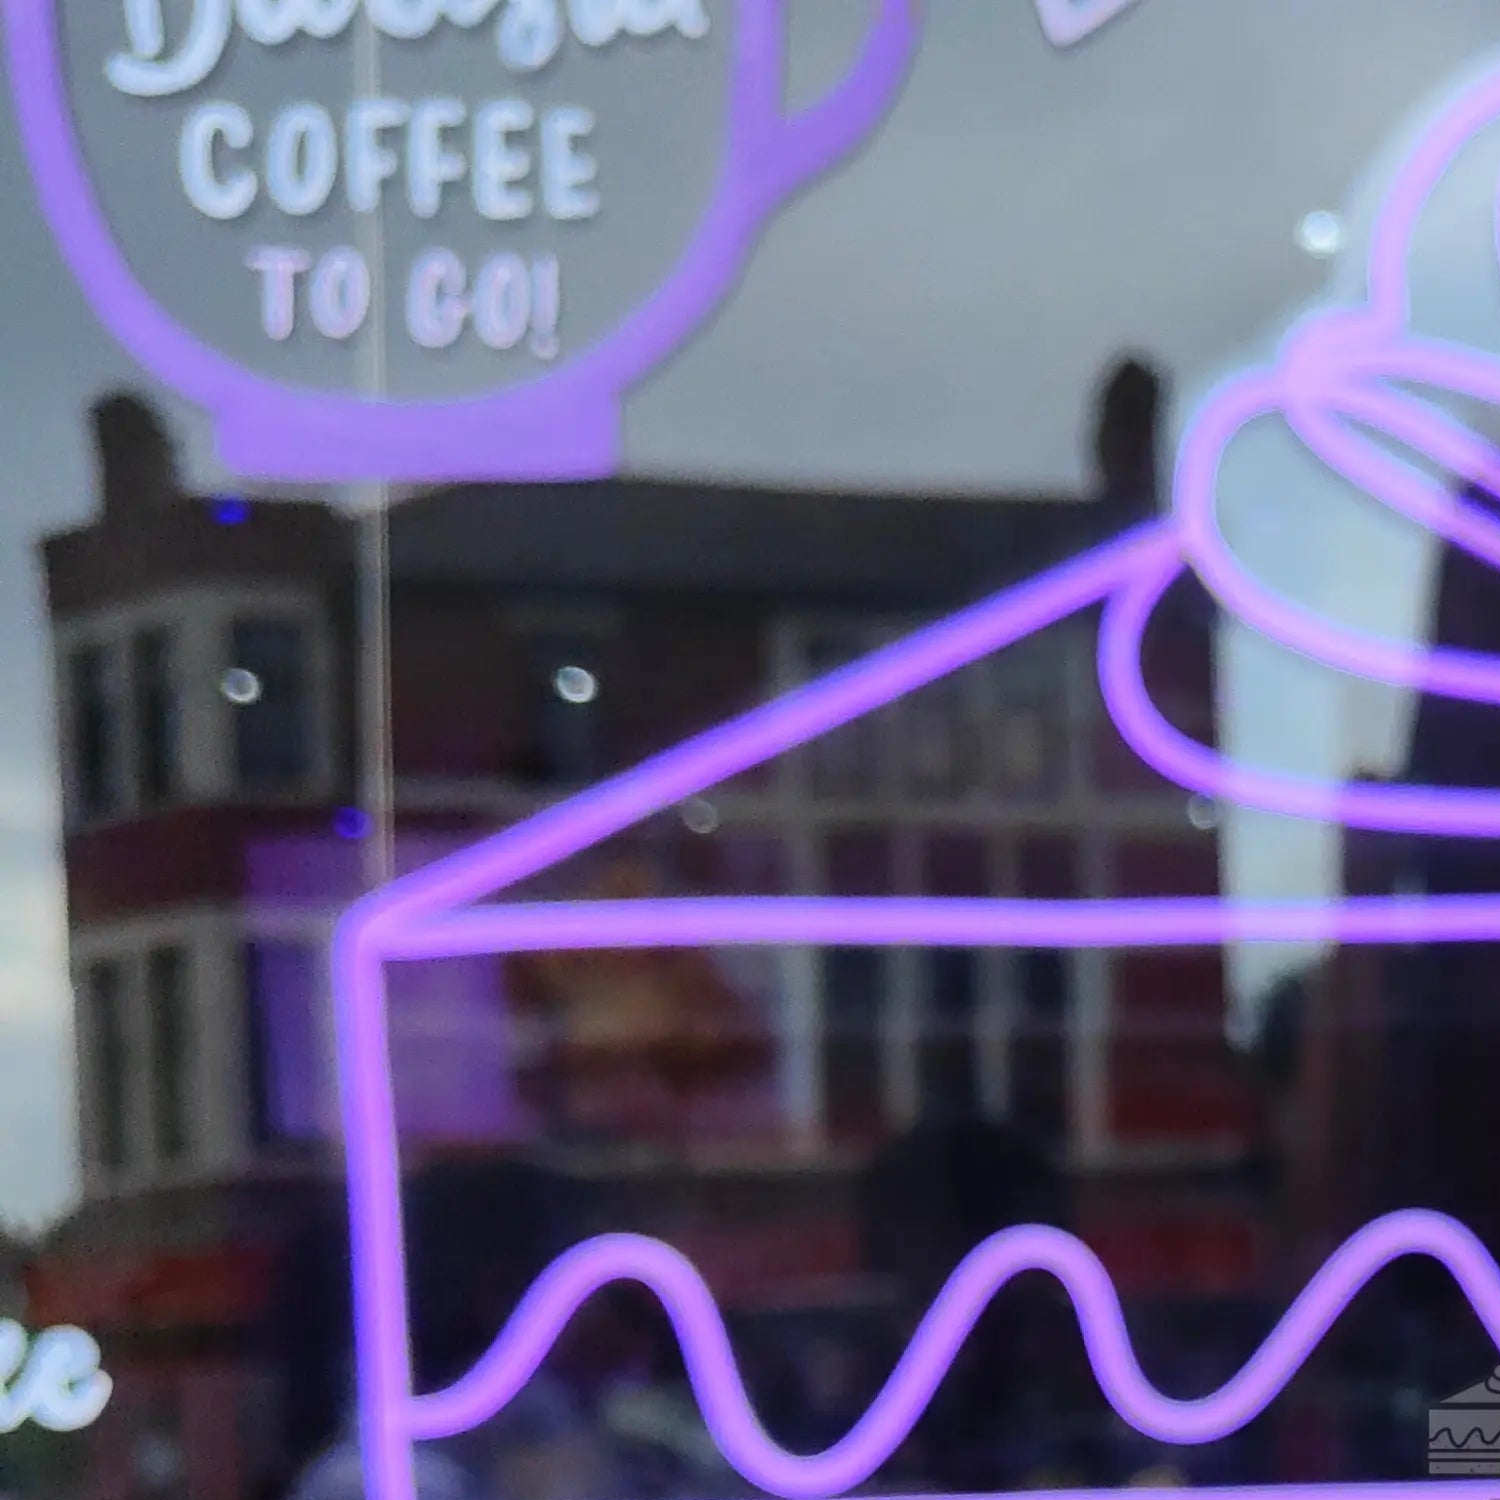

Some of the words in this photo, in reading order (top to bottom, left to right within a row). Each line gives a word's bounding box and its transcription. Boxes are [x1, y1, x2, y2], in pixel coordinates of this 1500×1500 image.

[178, 99, 600, 220] COFFEE
[246, 245, 371, 342] TO
[405, 246, 561, 360] GO!
